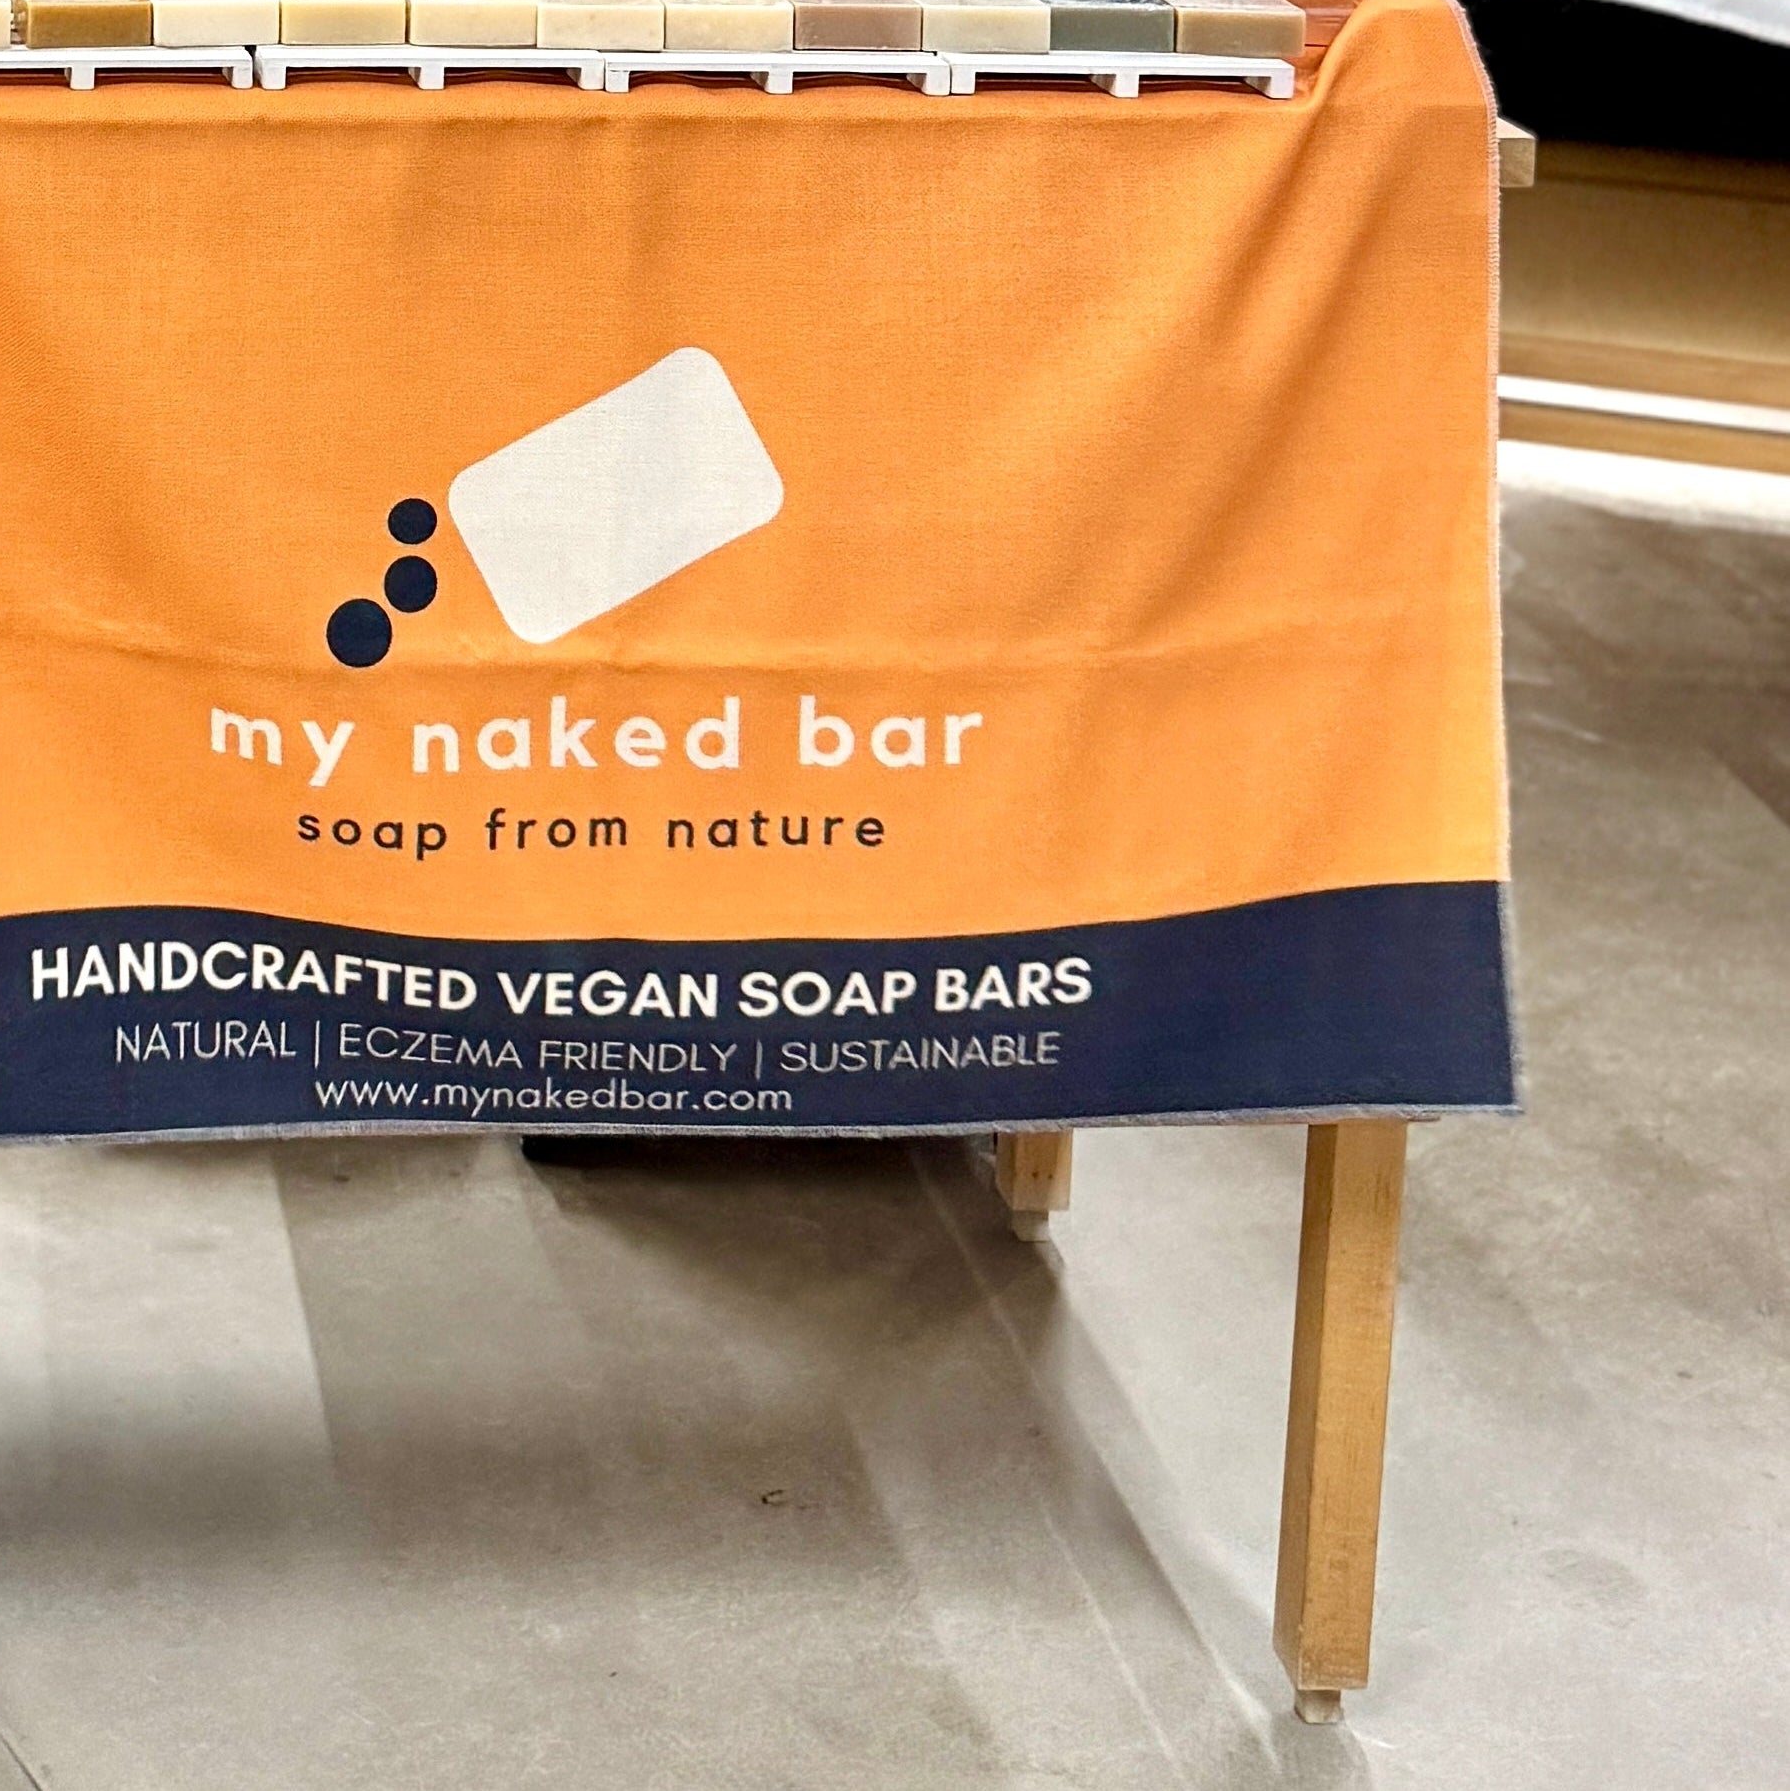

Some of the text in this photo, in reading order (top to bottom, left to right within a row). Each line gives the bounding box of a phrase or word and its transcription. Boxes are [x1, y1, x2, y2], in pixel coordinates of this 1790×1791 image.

[209, 694, 985, 788] my naked bar
[297, 807, 887, 861] soap from nature
[30, 941, 1094, 1020] HANDCRAFTED VEGAN SOAP BARS
[114, 1022, 1060, 1074] NATURAL ECZEMA FRIENDLY SUSTAINABLE
[314, 1077, 795, 1117] www.mynakedbar.com
